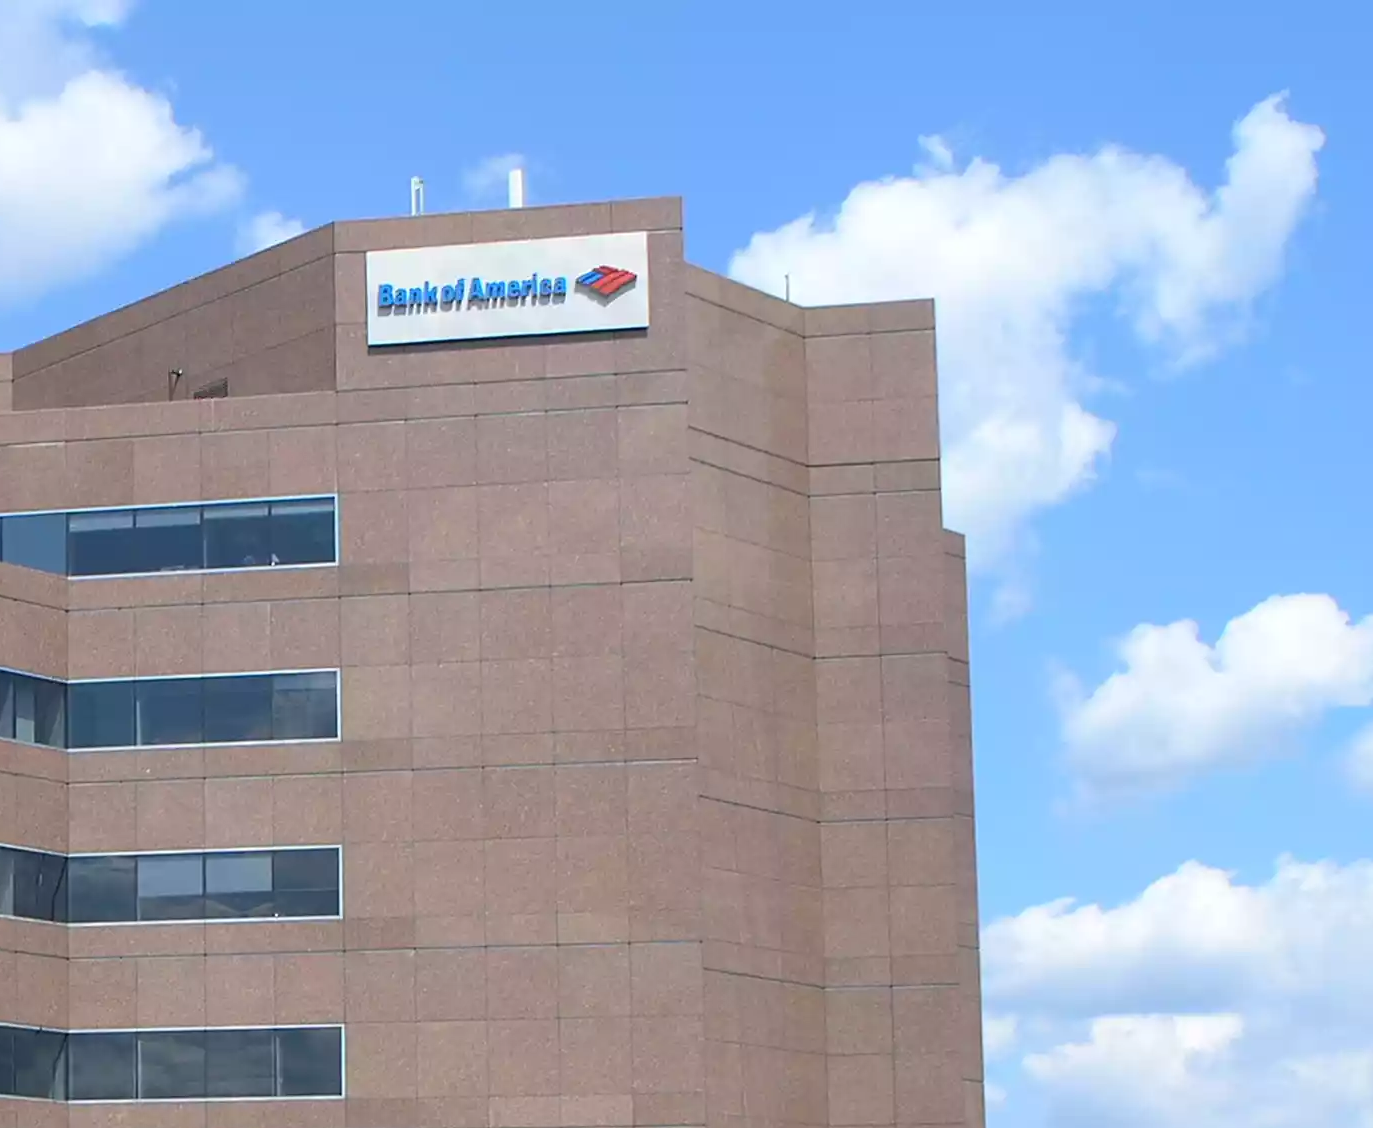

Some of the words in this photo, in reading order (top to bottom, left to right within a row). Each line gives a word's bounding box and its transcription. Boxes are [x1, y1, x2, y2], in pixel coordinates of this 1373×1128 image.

[378, 281, 440, 308] Bank
[443, 278, 466, 303] of
[469, 272, 567, 300] America
